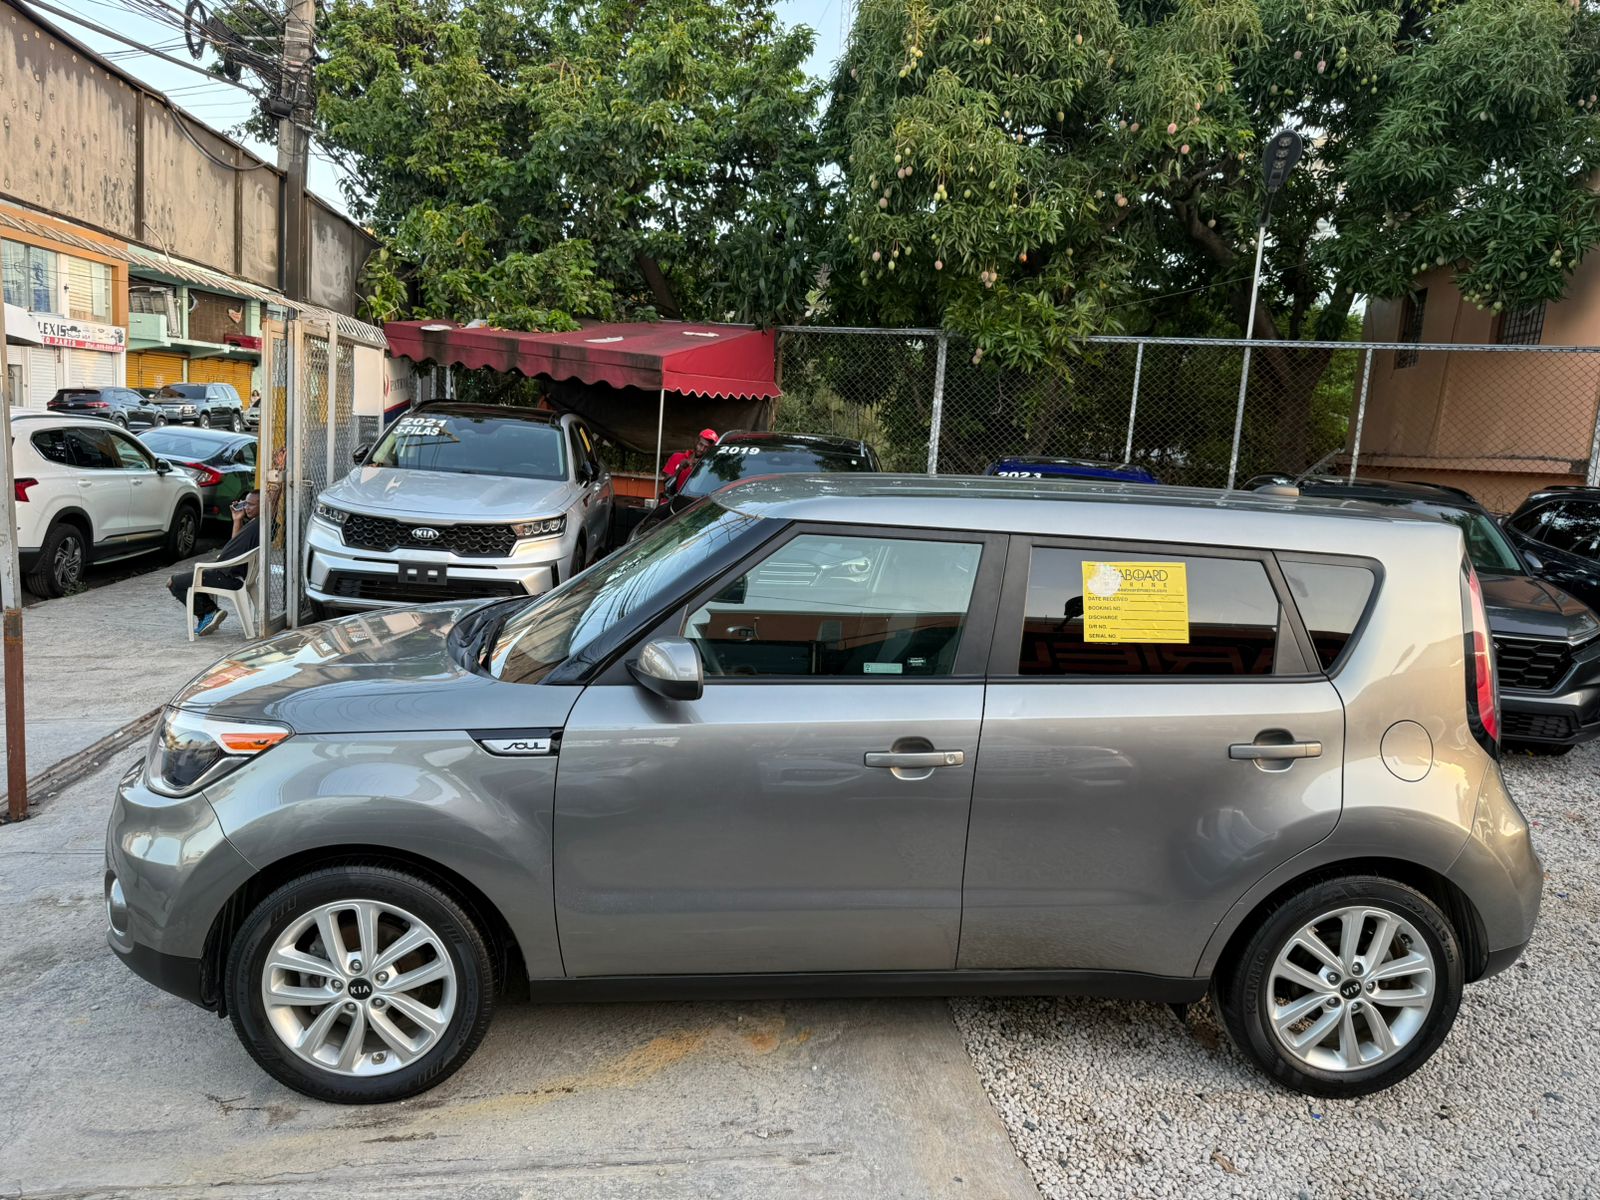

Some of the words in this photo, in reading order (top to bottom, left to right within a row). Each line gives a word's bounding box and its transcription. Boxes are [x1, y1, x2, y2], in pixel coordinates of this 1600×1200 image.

[400, 417, 447, 427] 2021
[392, 425, 441, 435] 3-FILAS
[717, 446, 760, 455] 2019
[1118, 568, 1168, 581] ABOARD
[503, 742, 546, 750] SOUL
[350, 985, 370, 994] KIA
[1342, 983, 1360, 996] KIA
